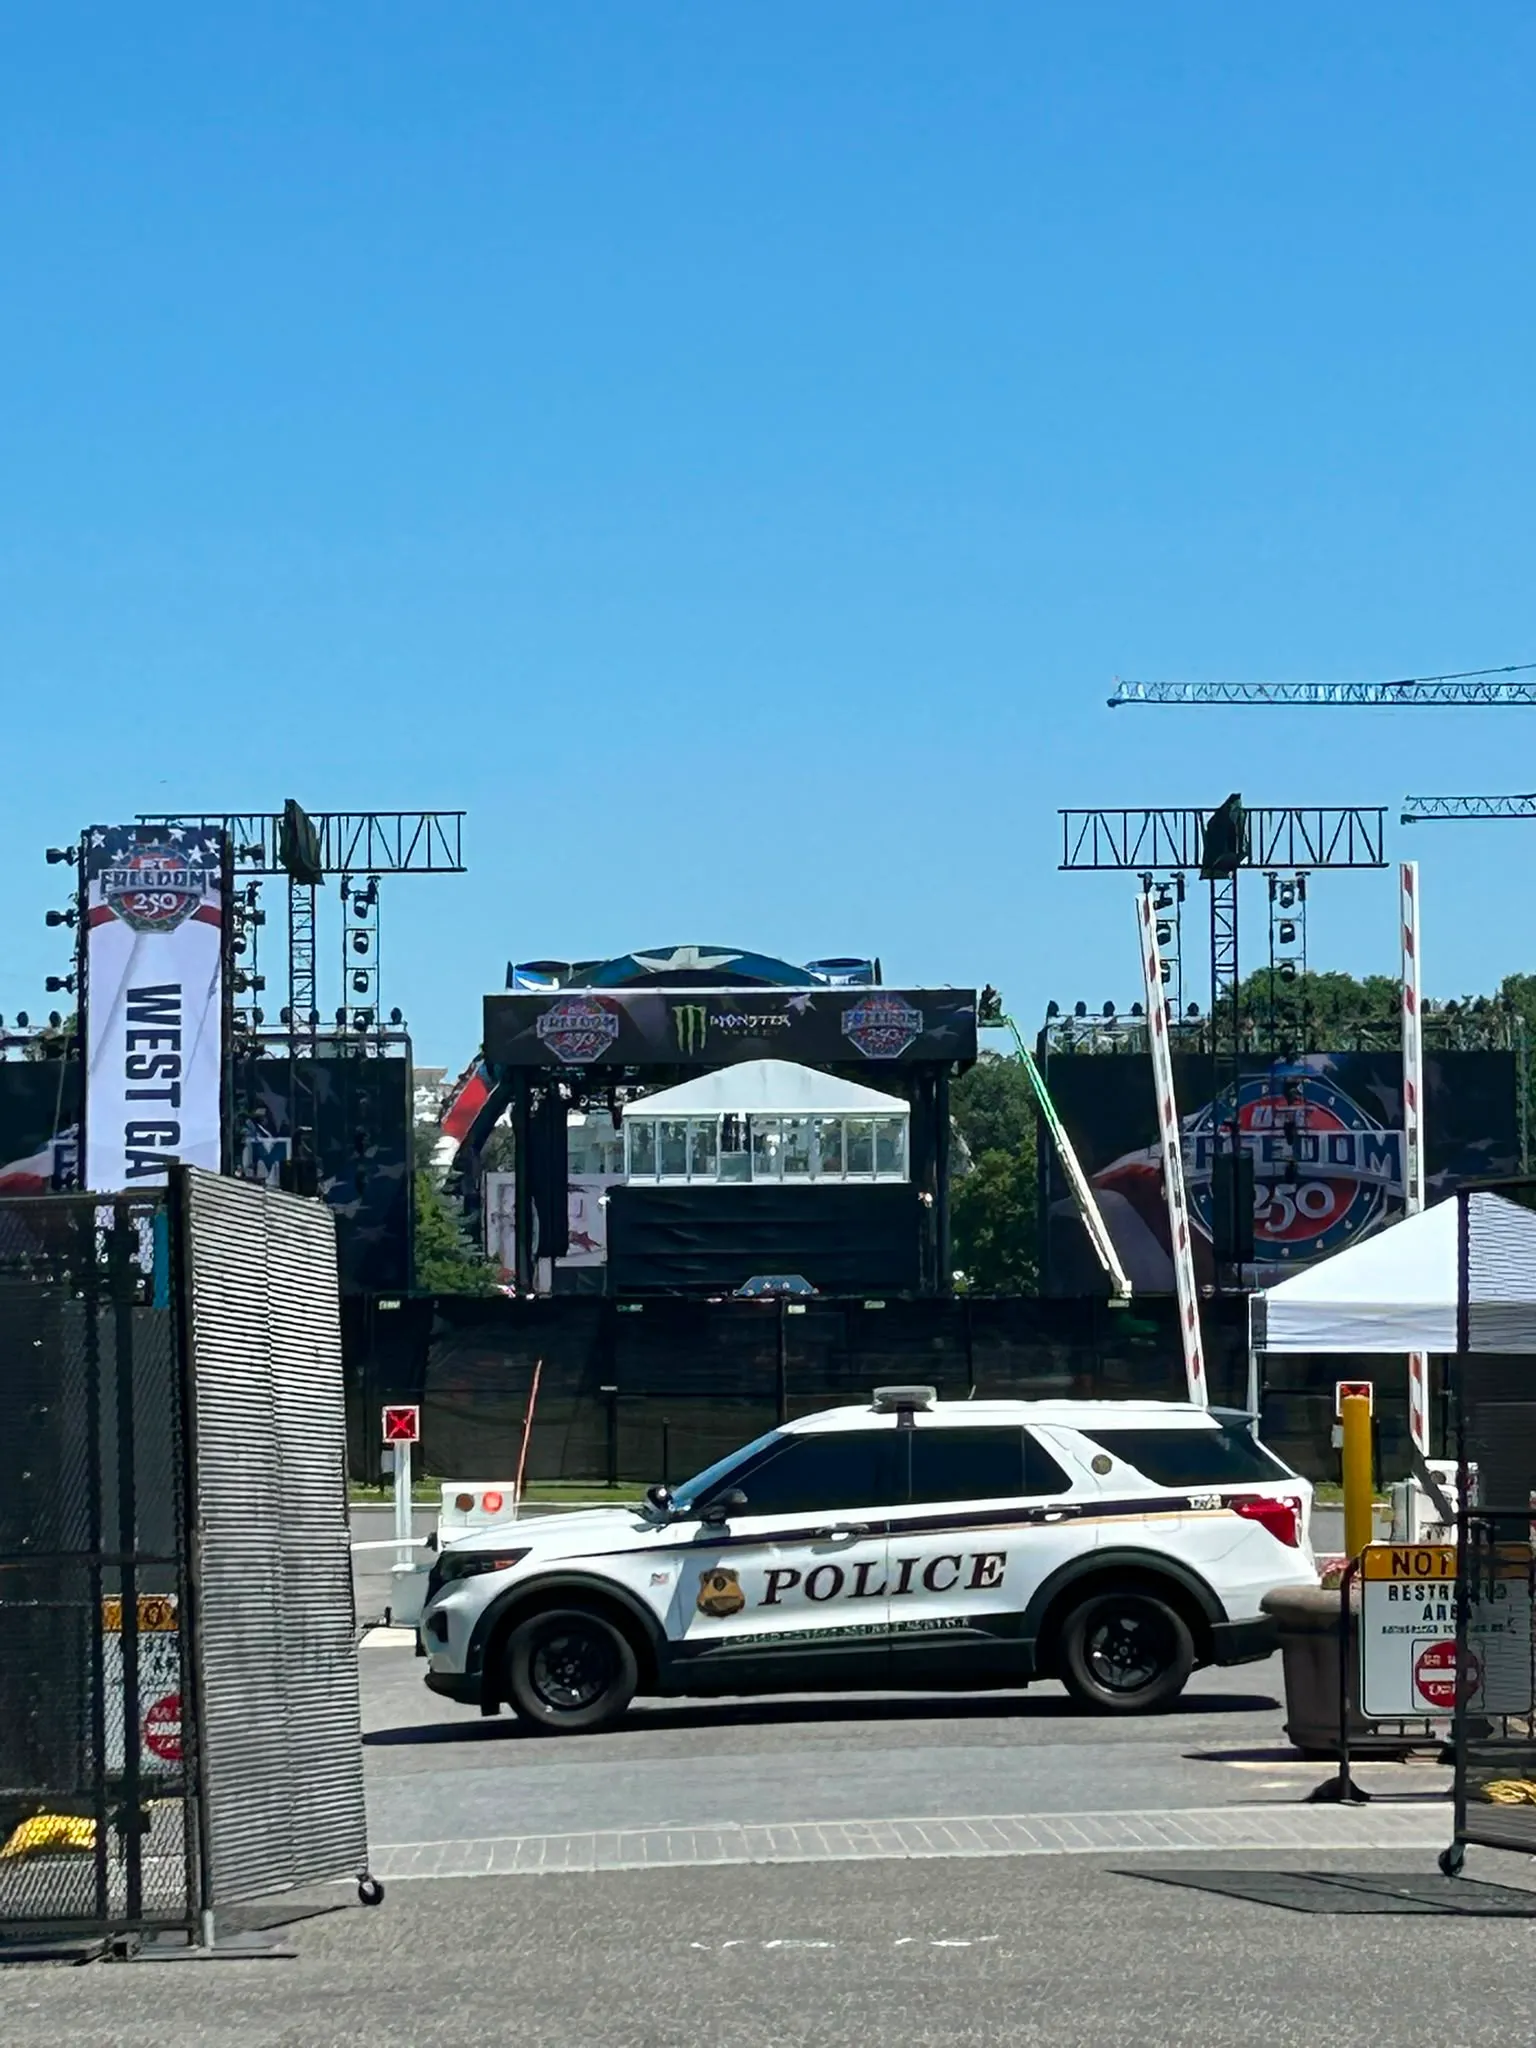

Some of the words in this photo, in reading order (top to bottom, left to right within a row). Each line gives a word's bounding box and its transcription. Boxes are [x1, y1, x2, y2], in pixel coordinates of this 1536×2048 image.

[132, 892, 178, 918] 250
[125, 983, 182, 1109] WEST
[124, 1120, 181, 1180] GA
[1180, 1132, 1402, 1182] REDOM
[1252, 1182, 1335, 1233] 250
[758, 1550, 1008, 1606] POLICE
[1391, 1551, 1453, 1577] NOT
[1422, 1603, 1473, 1621] ARE
